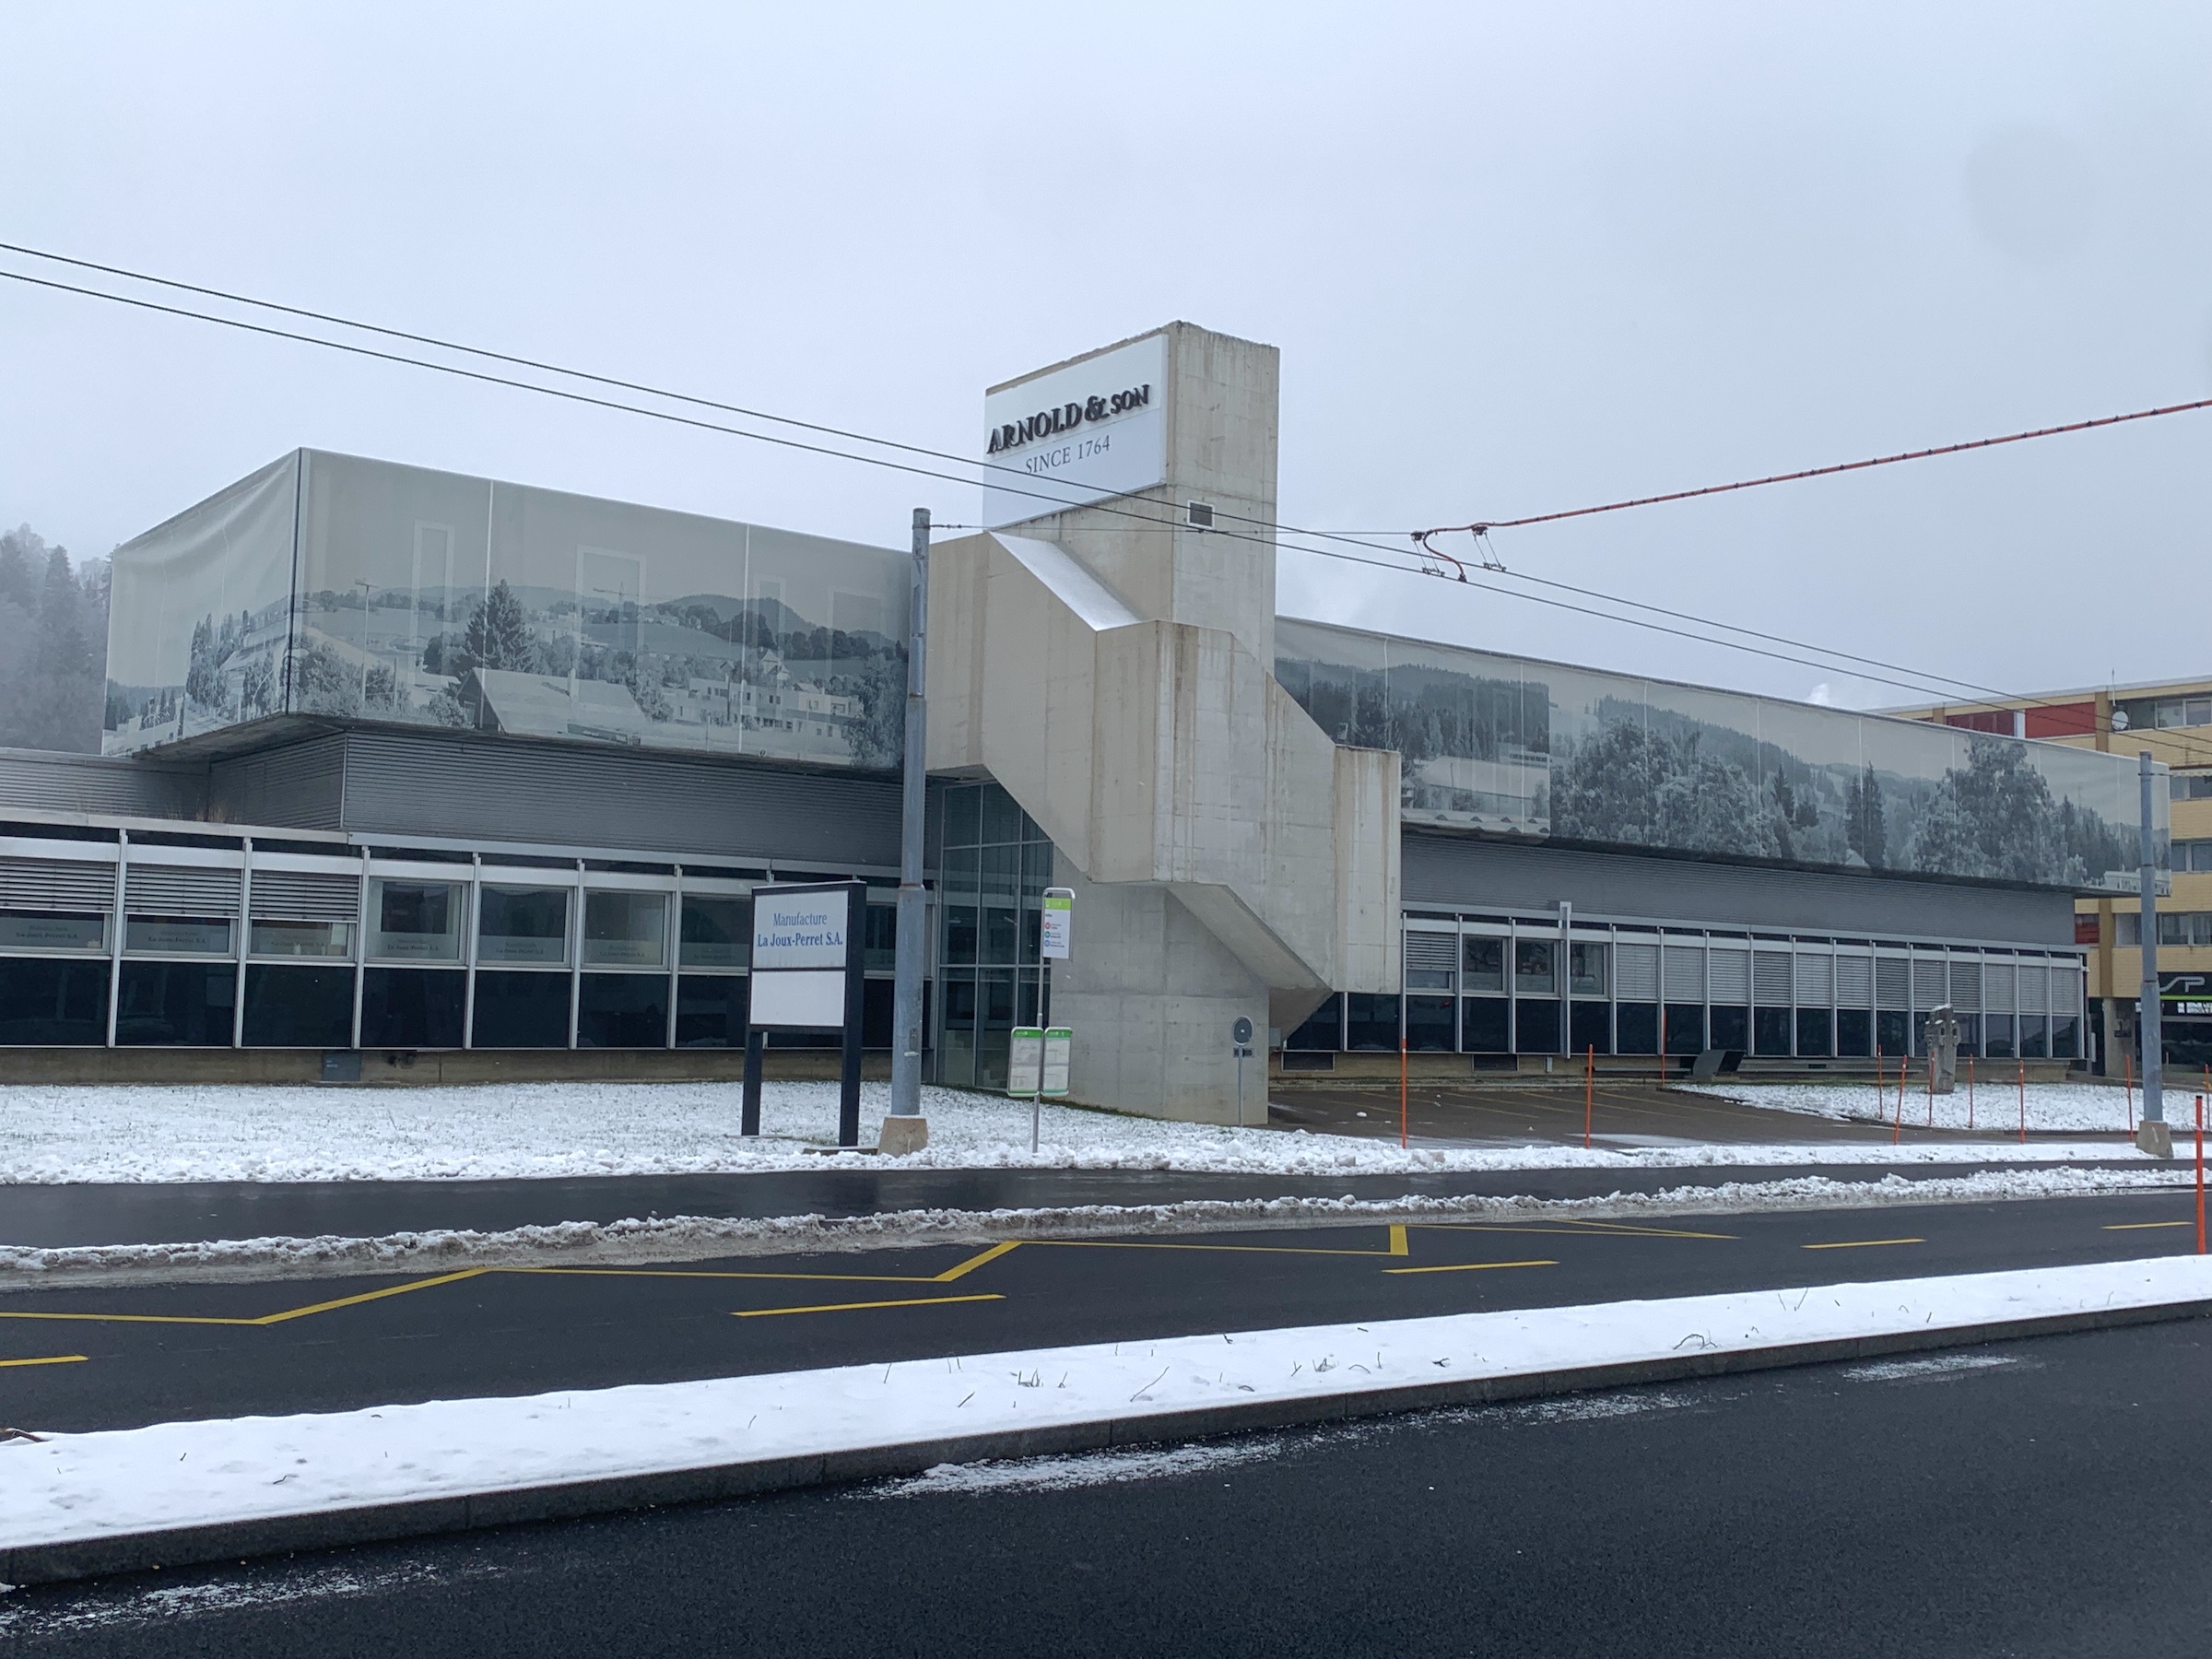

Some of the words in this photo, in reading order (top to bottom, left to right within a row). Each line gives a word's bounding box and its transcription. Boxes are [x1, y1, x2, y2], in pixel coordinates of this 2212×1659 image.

[986, 402, 1083, 454] ARNOLD
[1084, 394, 1111, 422] &
[1110, 383, 1150, 415] SON
[1025, 446, 1071, 475] SINCE
[1077, 434, 1111, 460] 1764
[773, 912, 828, 926] Manufacture
[757, 933, 769, 947] La
[770, 932, 824, 947] Joux-Perret
[826, 931, 843, 947] S.A.
